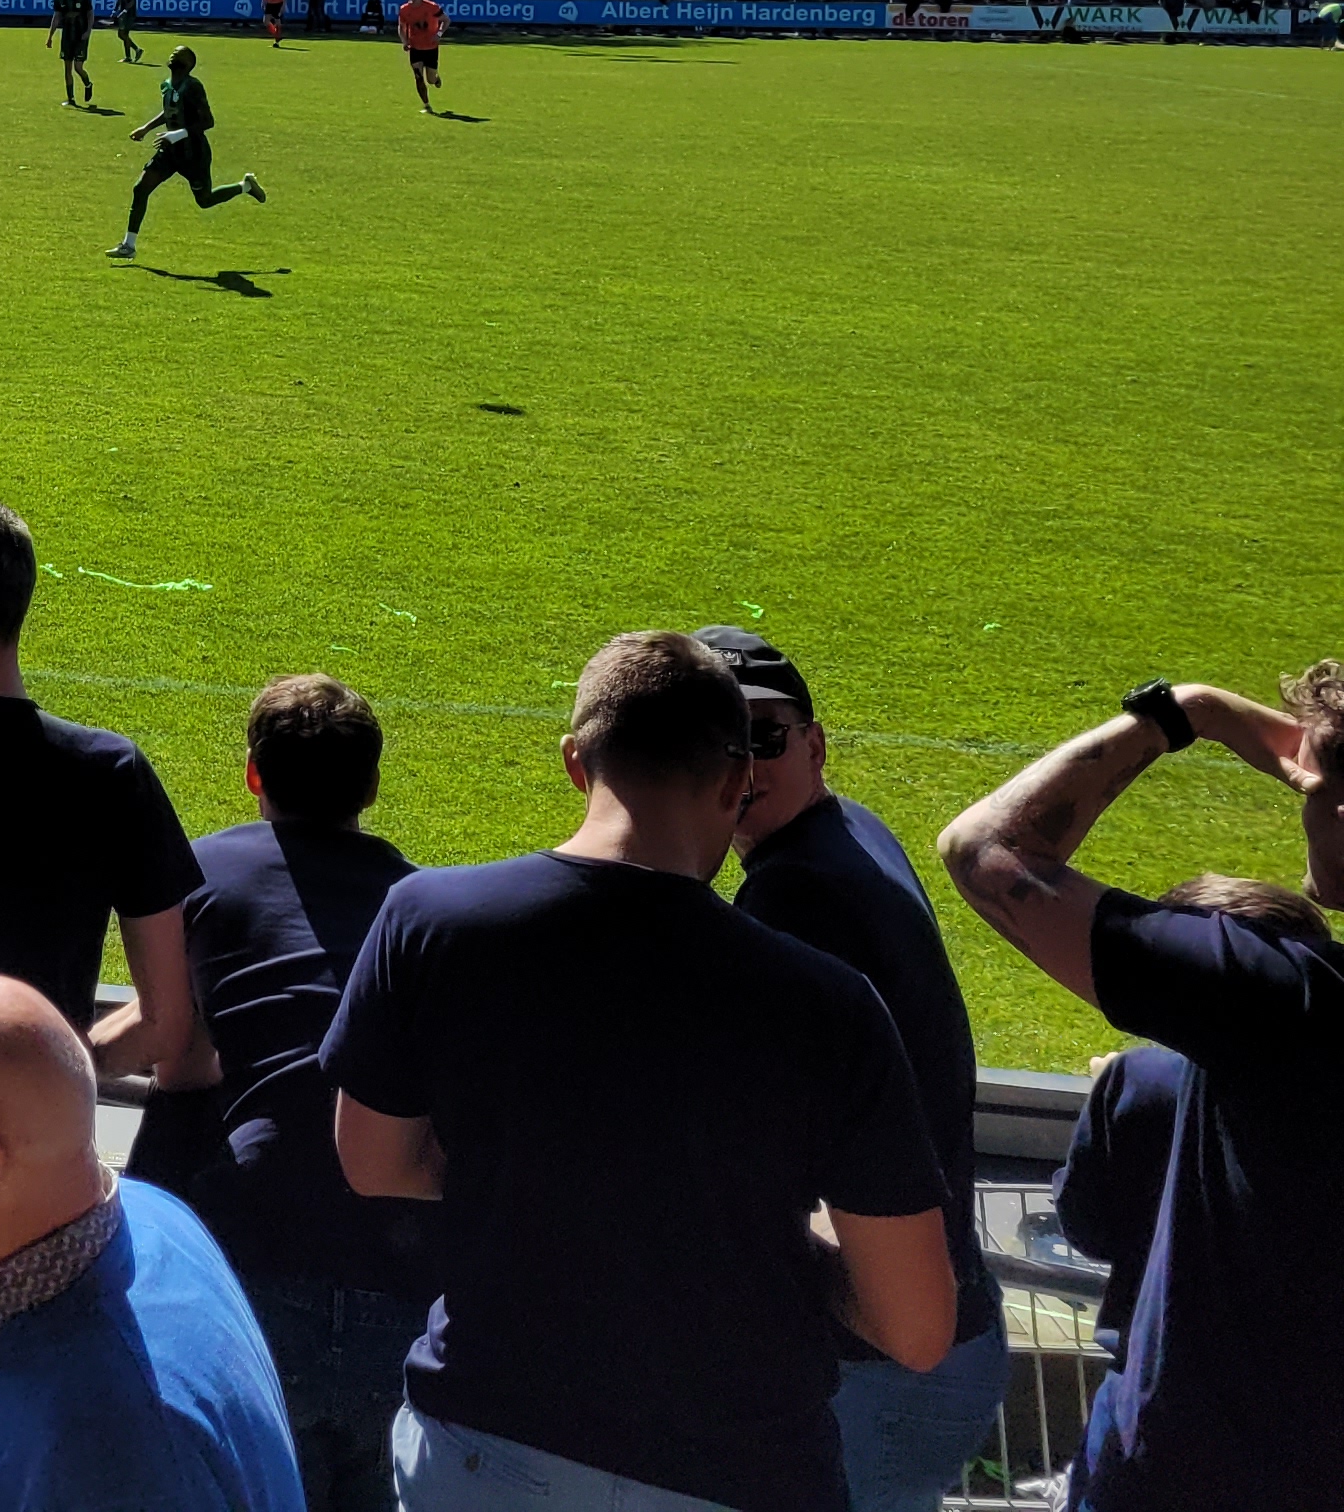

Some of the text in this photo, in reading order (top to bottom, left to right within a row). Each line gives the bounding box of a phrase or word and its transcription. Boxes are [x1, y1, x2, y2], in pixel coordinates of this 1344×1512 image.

[602, 1, 670, 19] Albert
[675, 2, 733, 24] Heijn
[741, 3, 877, 26] Hardenberg
[919, 13, 969, 27] toren
[1066, 6, 1143, 22] WARK
